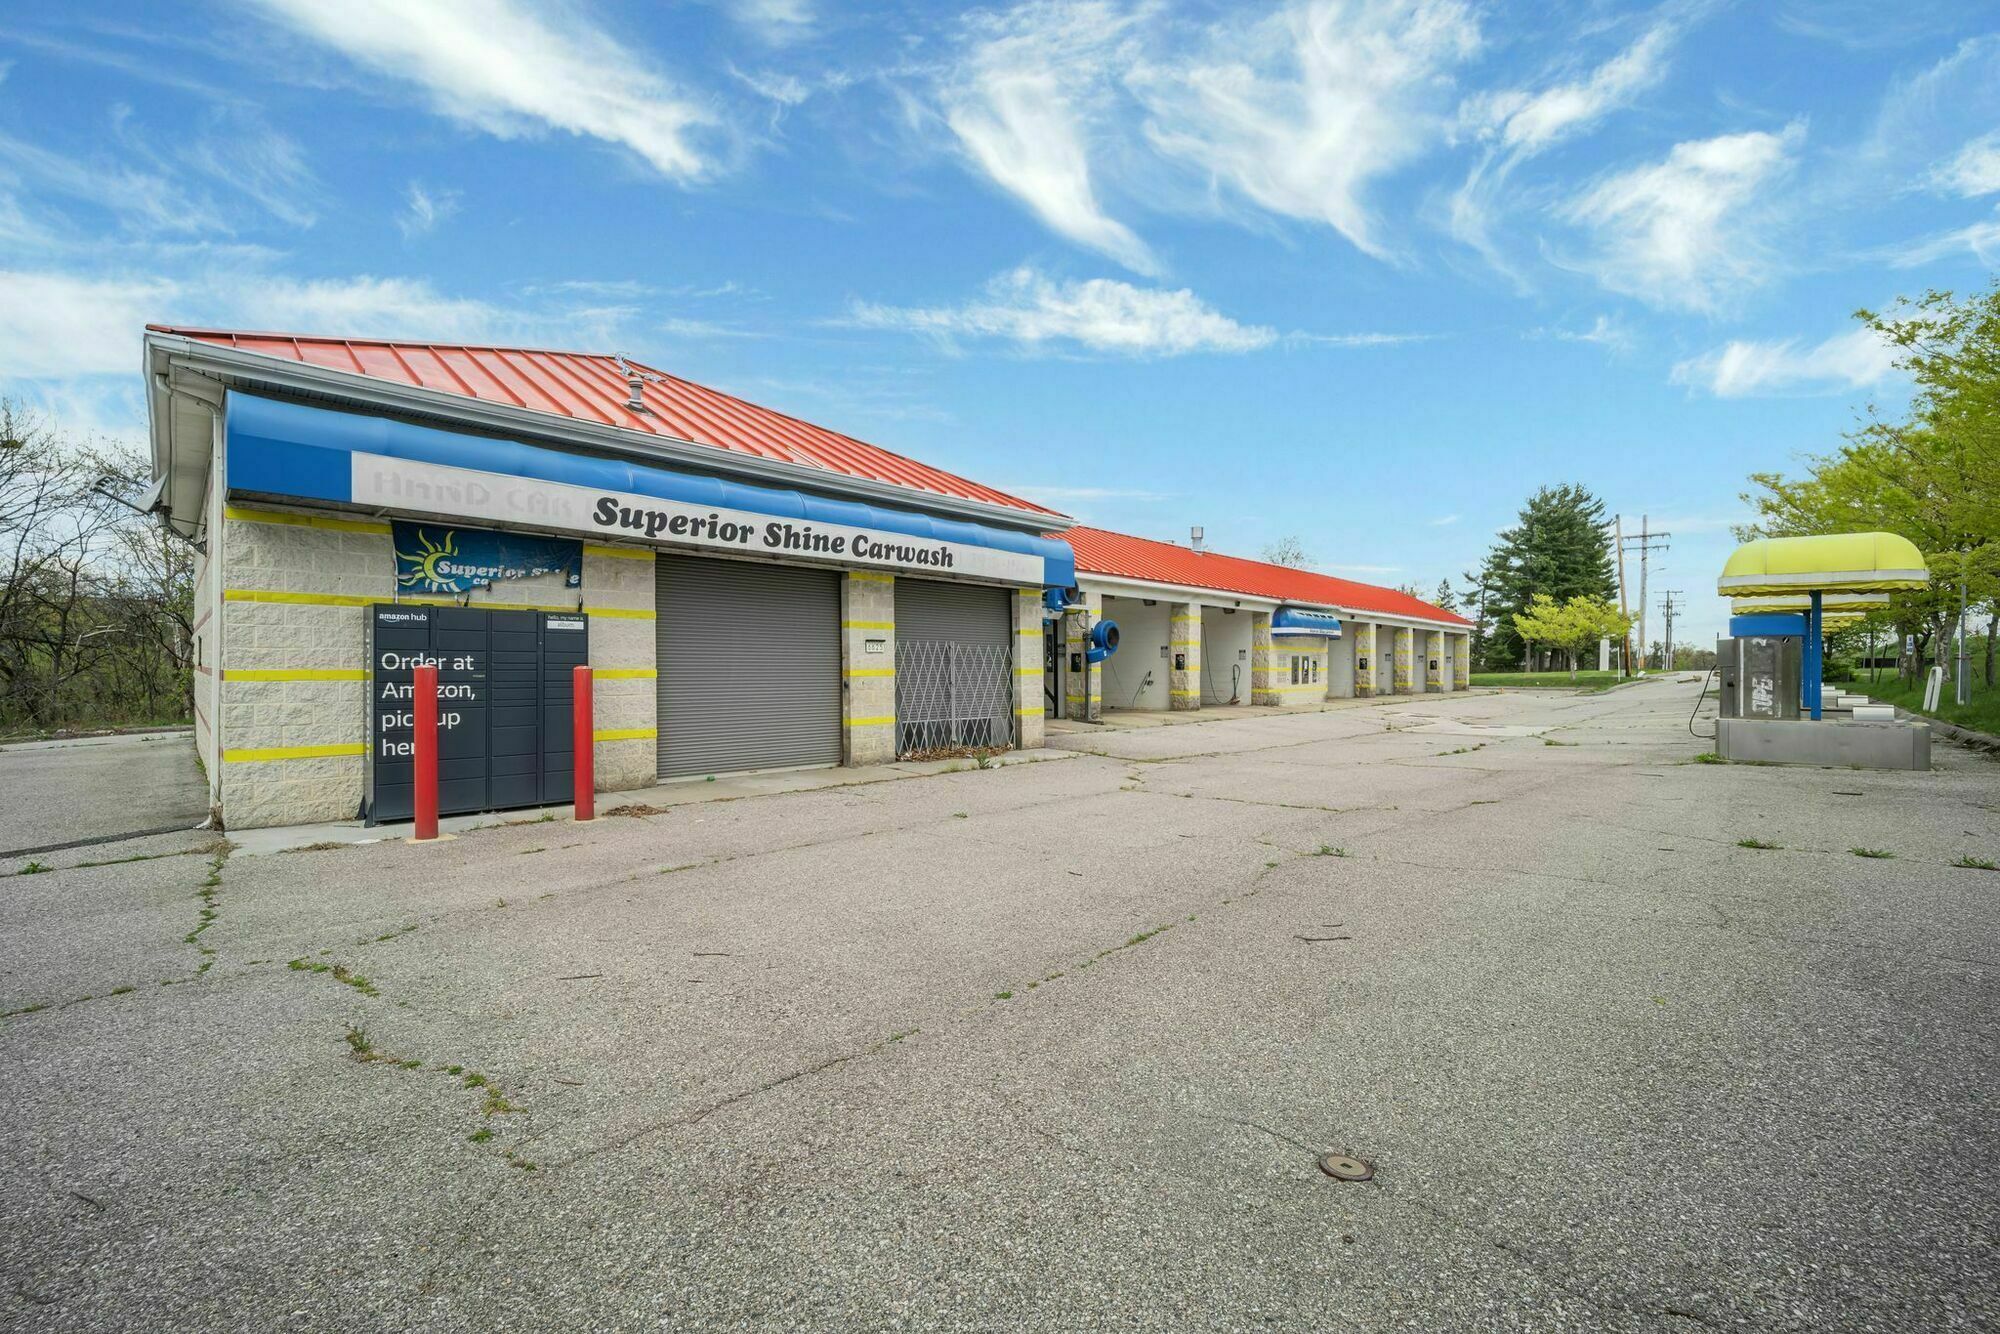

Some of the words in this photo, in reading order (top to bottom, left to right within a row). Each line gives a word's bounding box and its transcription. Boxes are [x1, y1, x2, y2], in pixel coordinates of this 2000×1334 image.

[592, 497, 755, 544] Superior
[763, 522, 846, 554] Shine
[851, 534, 954, 568] Carwash
[379, 613, 410, 622] amazon
[411, 613, 427, 621] hub
[381, 652, 447, 670] Order
[453, 655, 474, 670] at
[381, 682, 476, 701] Amzon,
[382, 710, 415, 732] pic
[382, 739, 415, 757] her
